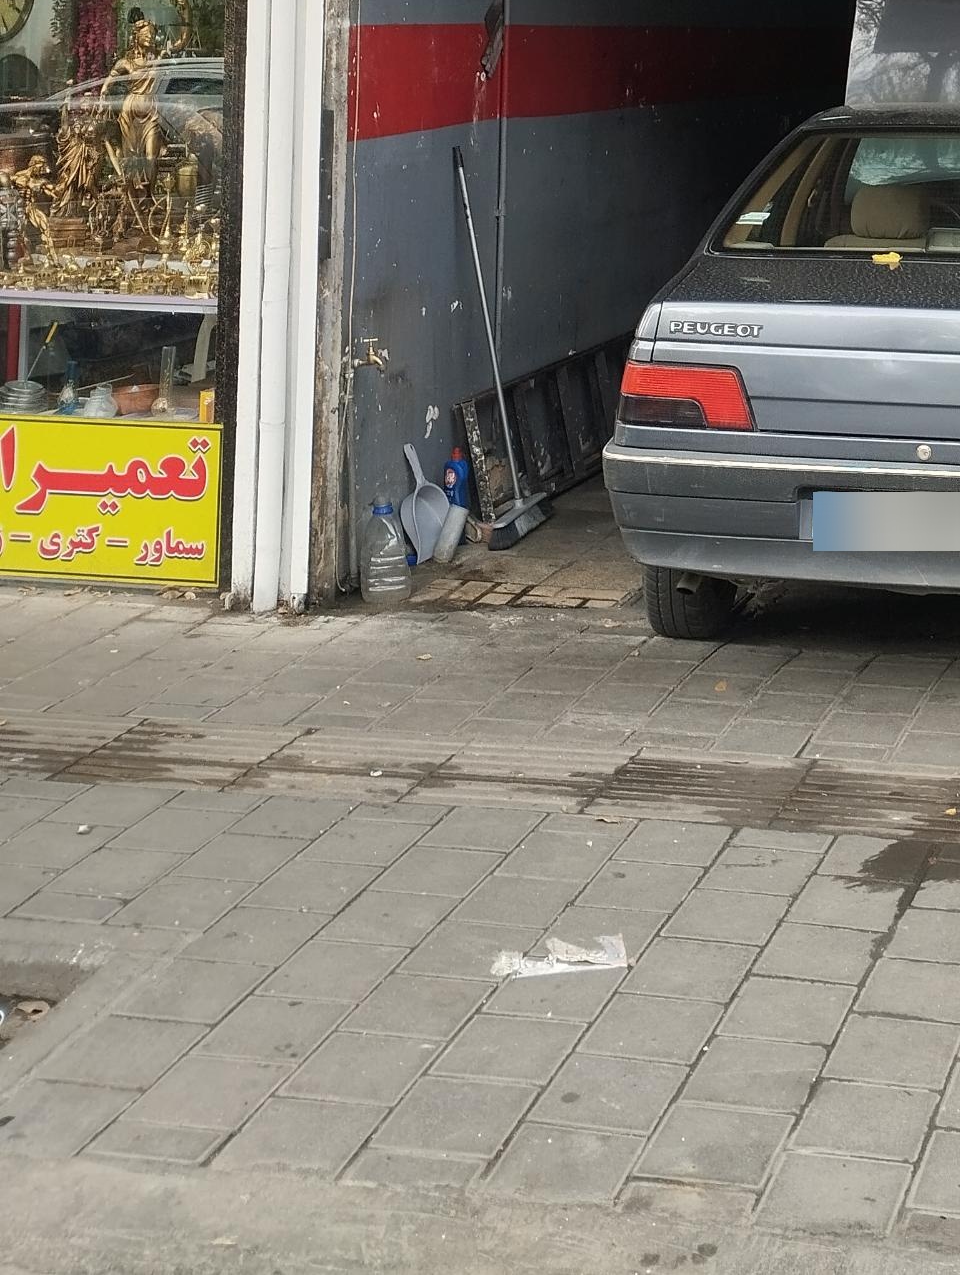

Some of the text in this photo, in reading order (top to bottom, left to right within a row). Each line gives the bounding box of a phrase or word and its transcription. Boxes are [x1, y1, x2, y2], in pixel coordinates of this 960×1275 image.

[670, 321, 763, 338] PEUGEOT
[38, 524, 101, 560] کتری
[135, 527, 205, 566] سماور
